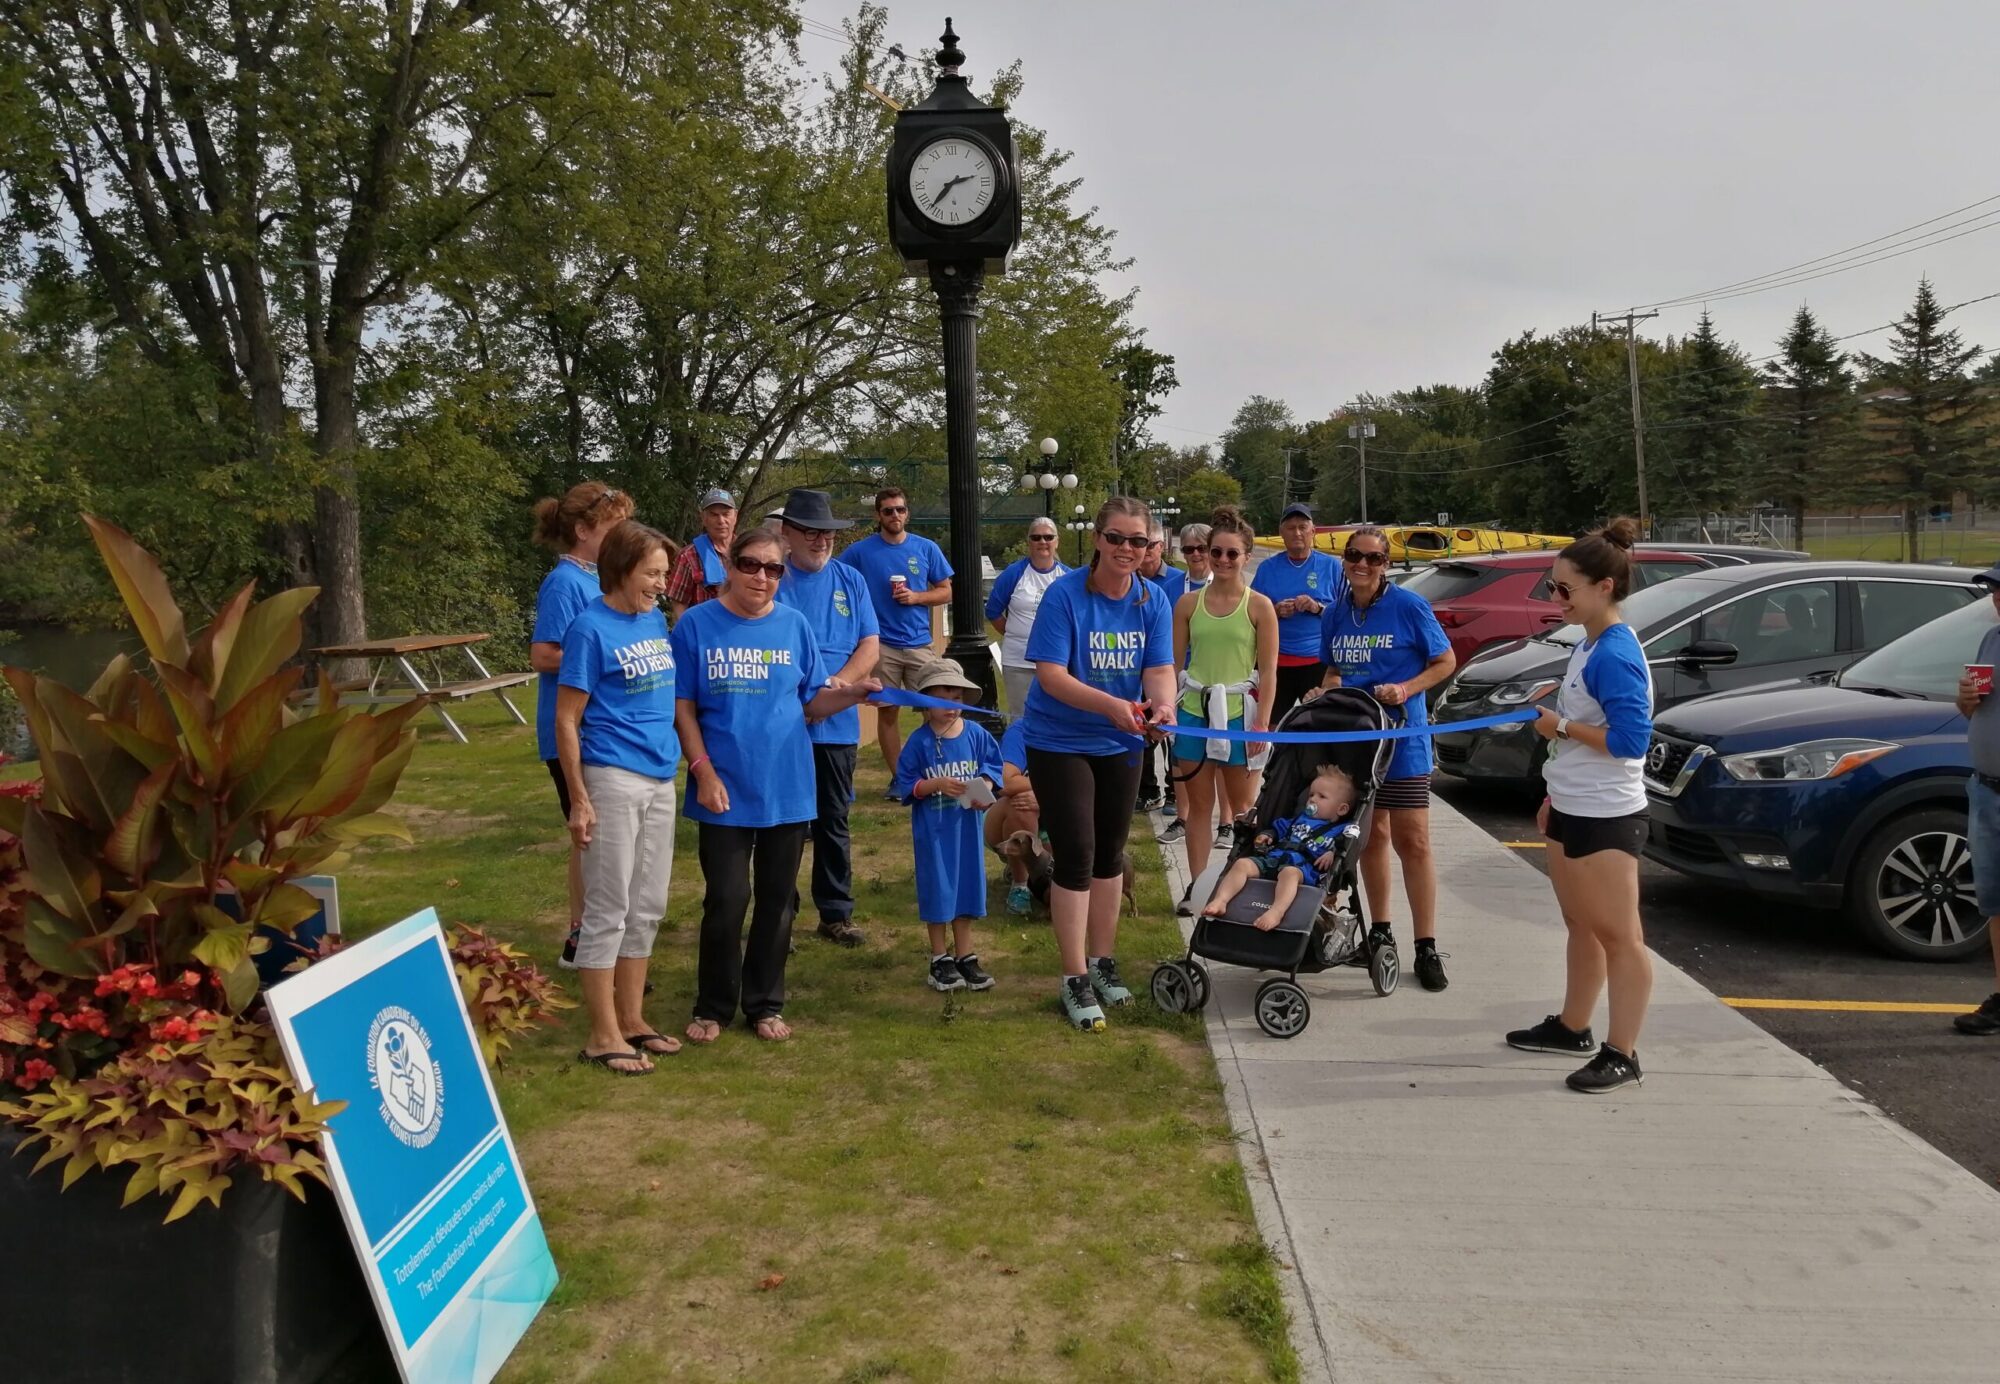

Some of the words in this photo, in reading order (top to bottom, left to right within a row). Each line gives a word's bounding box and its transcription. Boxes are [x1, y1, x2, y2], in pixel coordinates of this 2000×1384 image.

[929, 149, 941, 162] XI
[945, 145, 957, 156] XII
[964, 149, 971, 159] I
[918, 164, 929, 174] X
[975, 160, 985, 170] II
[980, 176, 990, 187] III
[614, 646, 638, 665] LA
[706, 647, 725, 664] LA
[1089, 651, 1136, 670] WALK
[1345, 649, 1371, 663] REIN
[623, 658, 648, 680] DU
[645, 652, 674, 673] REIN
[708, 663, 728, 681] DU
[733, 663, 768, 680] REIN
[367, 1019, 381, 1073] FONDATION
[370, 1075, 380, 1090] LA
[379, 1101, 391, 1125] THE
[389, 1120, 412, 1147] KIDNEY
[393, 1235, 437, 1285] Totalement
[434, 1207, 463, 1244] dévouée
[461, 1198, 474, 1216] aux
[416, 1279, 433, 1300] The
[431, 1244, 468, 1291] foundation
